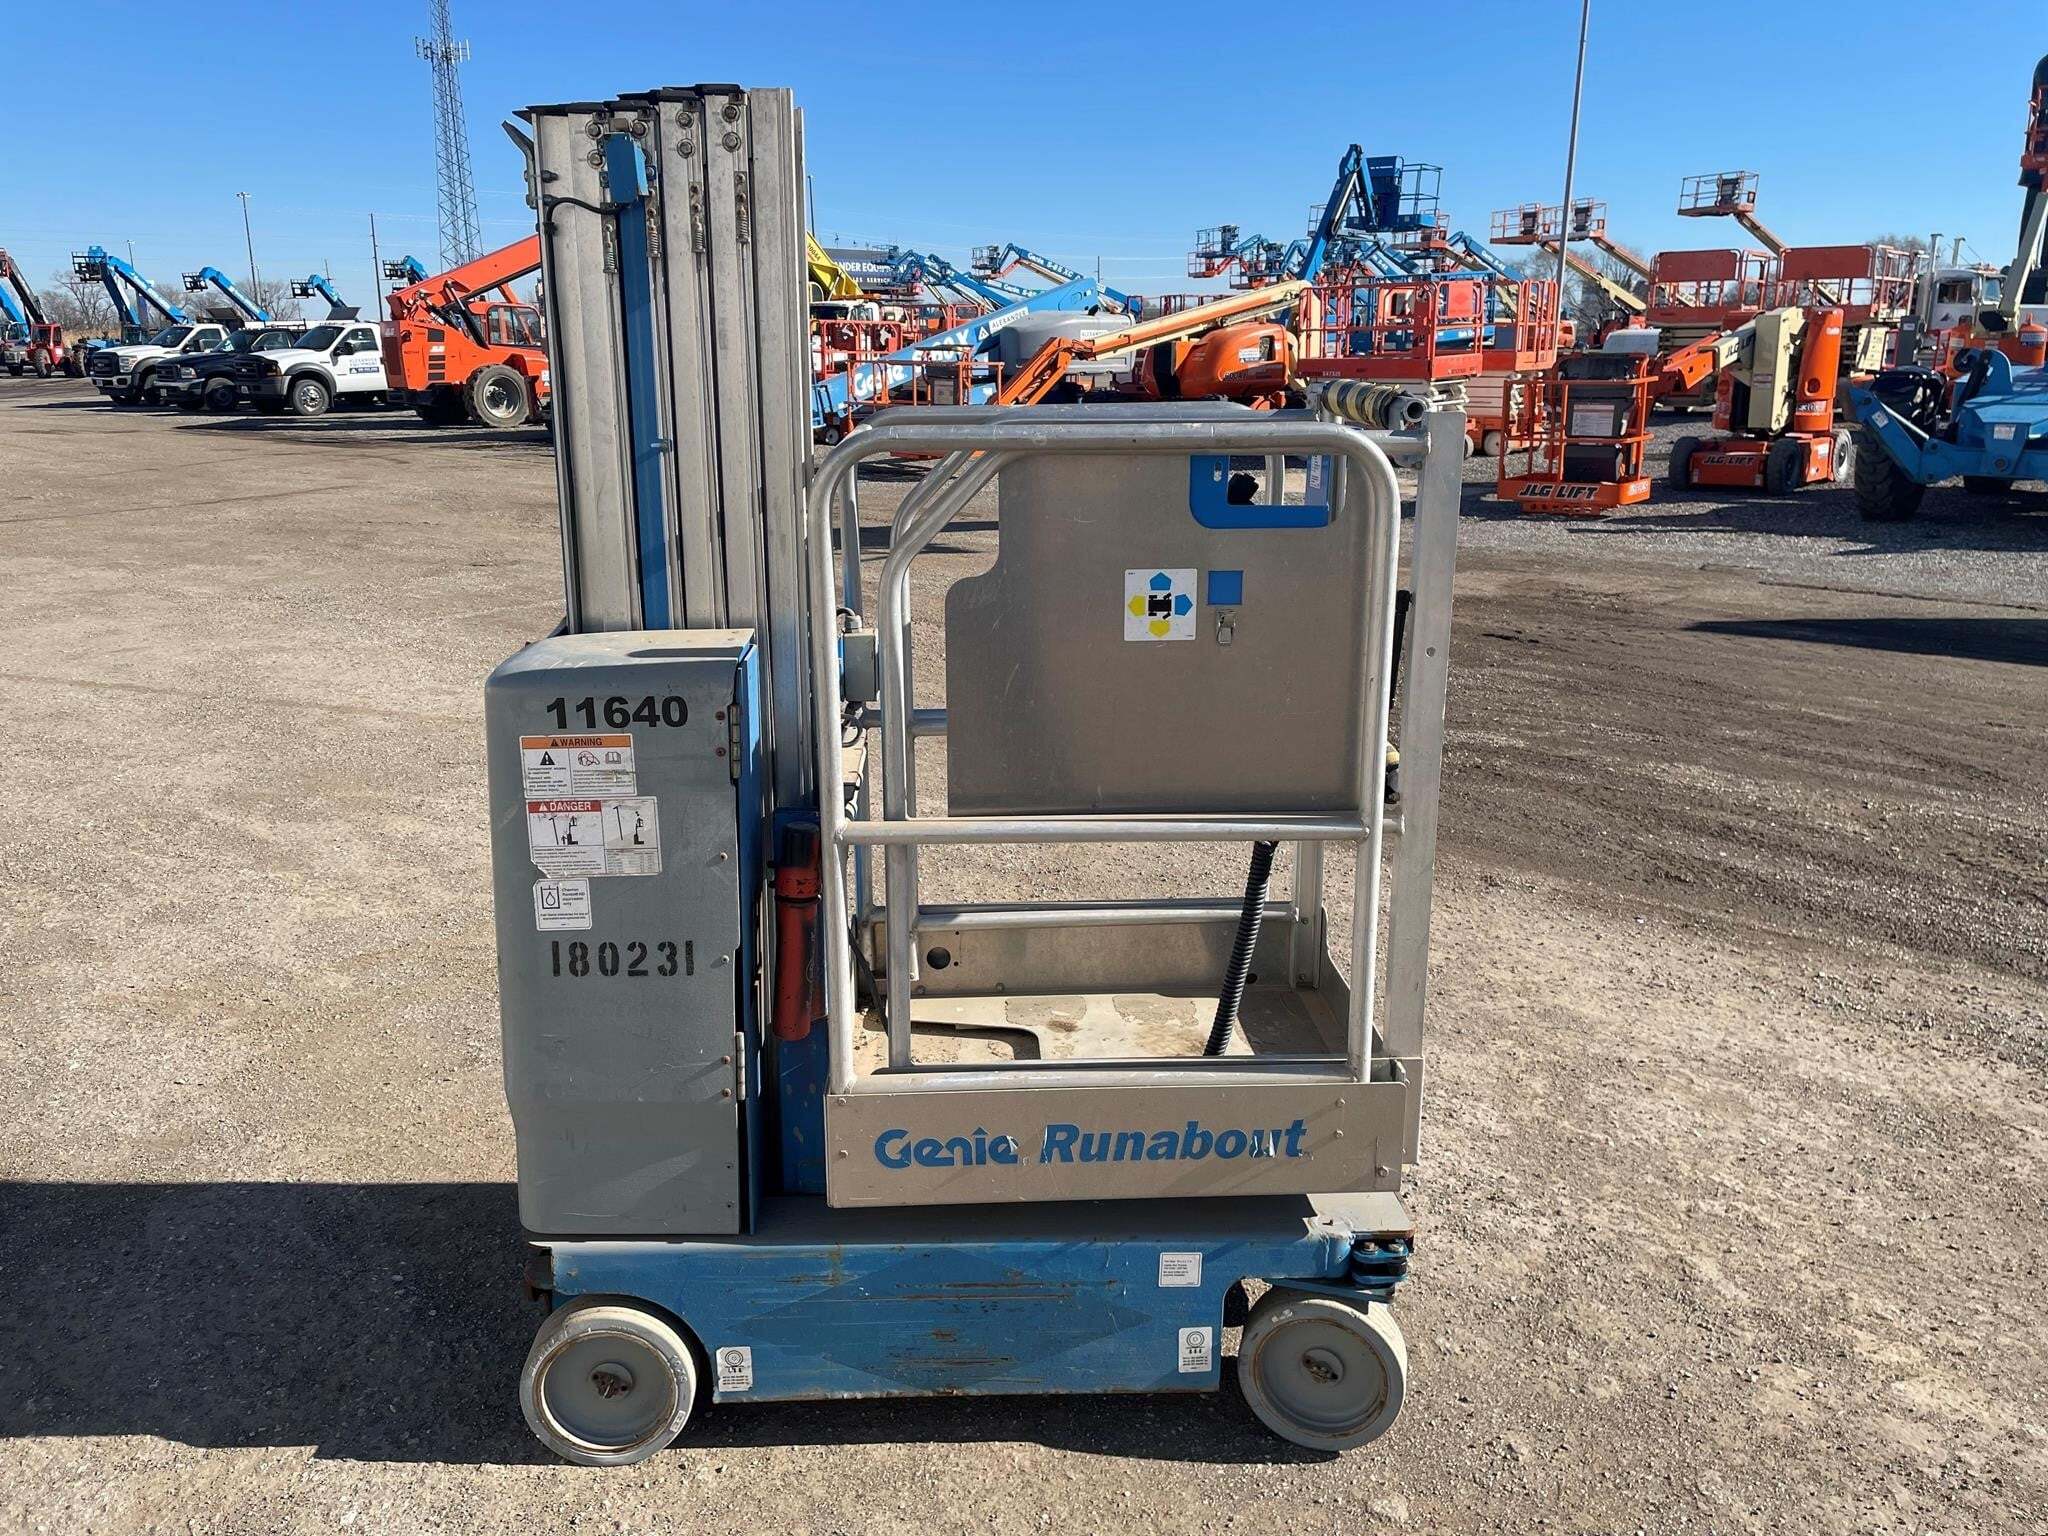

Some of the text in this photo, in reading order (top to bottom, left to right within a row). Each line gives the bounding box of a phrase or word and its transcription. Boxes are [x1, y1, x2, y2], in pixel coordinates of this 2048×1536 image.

[1703, 455, 1755, 466] JLG LIFT
[1519, 483, 1599, 499] JLG LIFT
[546, 695, 688, 730] 11640
[560, 737, 603, 747] WARNING
[549, 801, 592, 812] DANGER
[873, 1118, 1308, 1170] Genie Runabout
